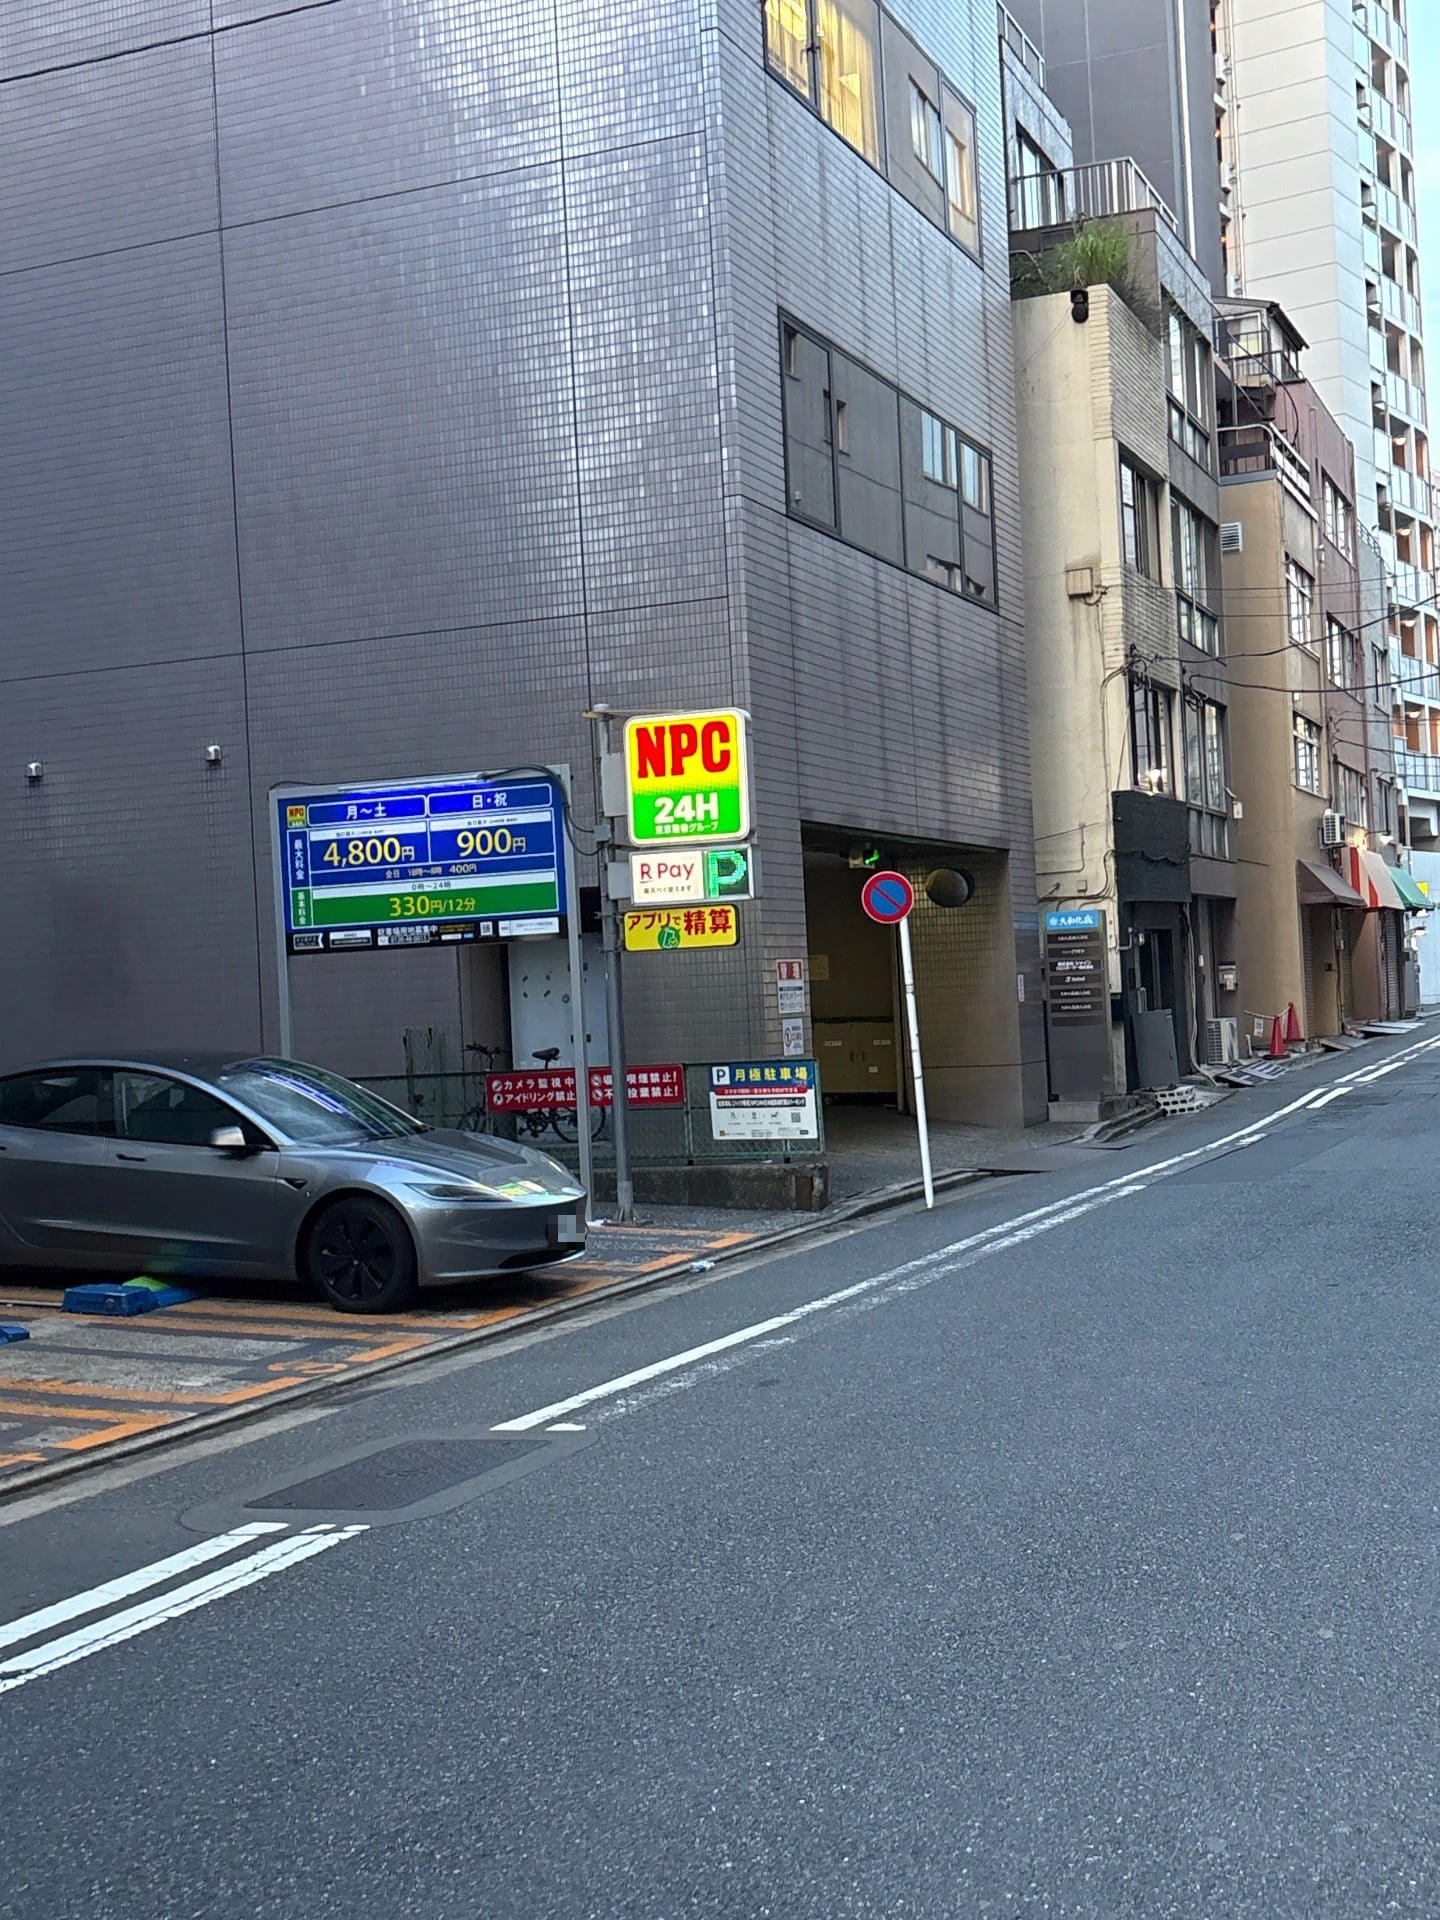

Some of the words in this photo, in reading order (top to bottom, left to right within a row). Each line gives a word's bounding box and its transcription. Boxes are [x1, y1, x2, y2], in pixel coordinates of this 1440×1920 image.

[636, 721, 730, 778] NPC
[472, 792, 507, 809] 日・祝
[654, 792, 719, 824] 24H
[288, 807, 305, 817] NPC
[456, 828, 526, 857] 900円
[323, 837, 415, 868] 4,800円
[386, 869, 400, 879] 全日
[449, 864, 478, 875] 400円
[640, 863, 652, 883] R
[657, 862, 694, 880] Pay
[706, 850, 747, 898] P
[389, 895, 476, 917] 330円/12分
[628, 908, 732, 936] アプリで精算
[504, 1076, 576, 1089] カメラ監視中
[603, 1071, 677, 1085] 場喫煙禁止!
[716, 1069, 726, 1082] P
[735, 1066, 808, 1082] 月極駐車場
[505, 1089, 576, 1104] アイドリング禁止
[604, 1085, 679, 1098] 不投棄禁止!
